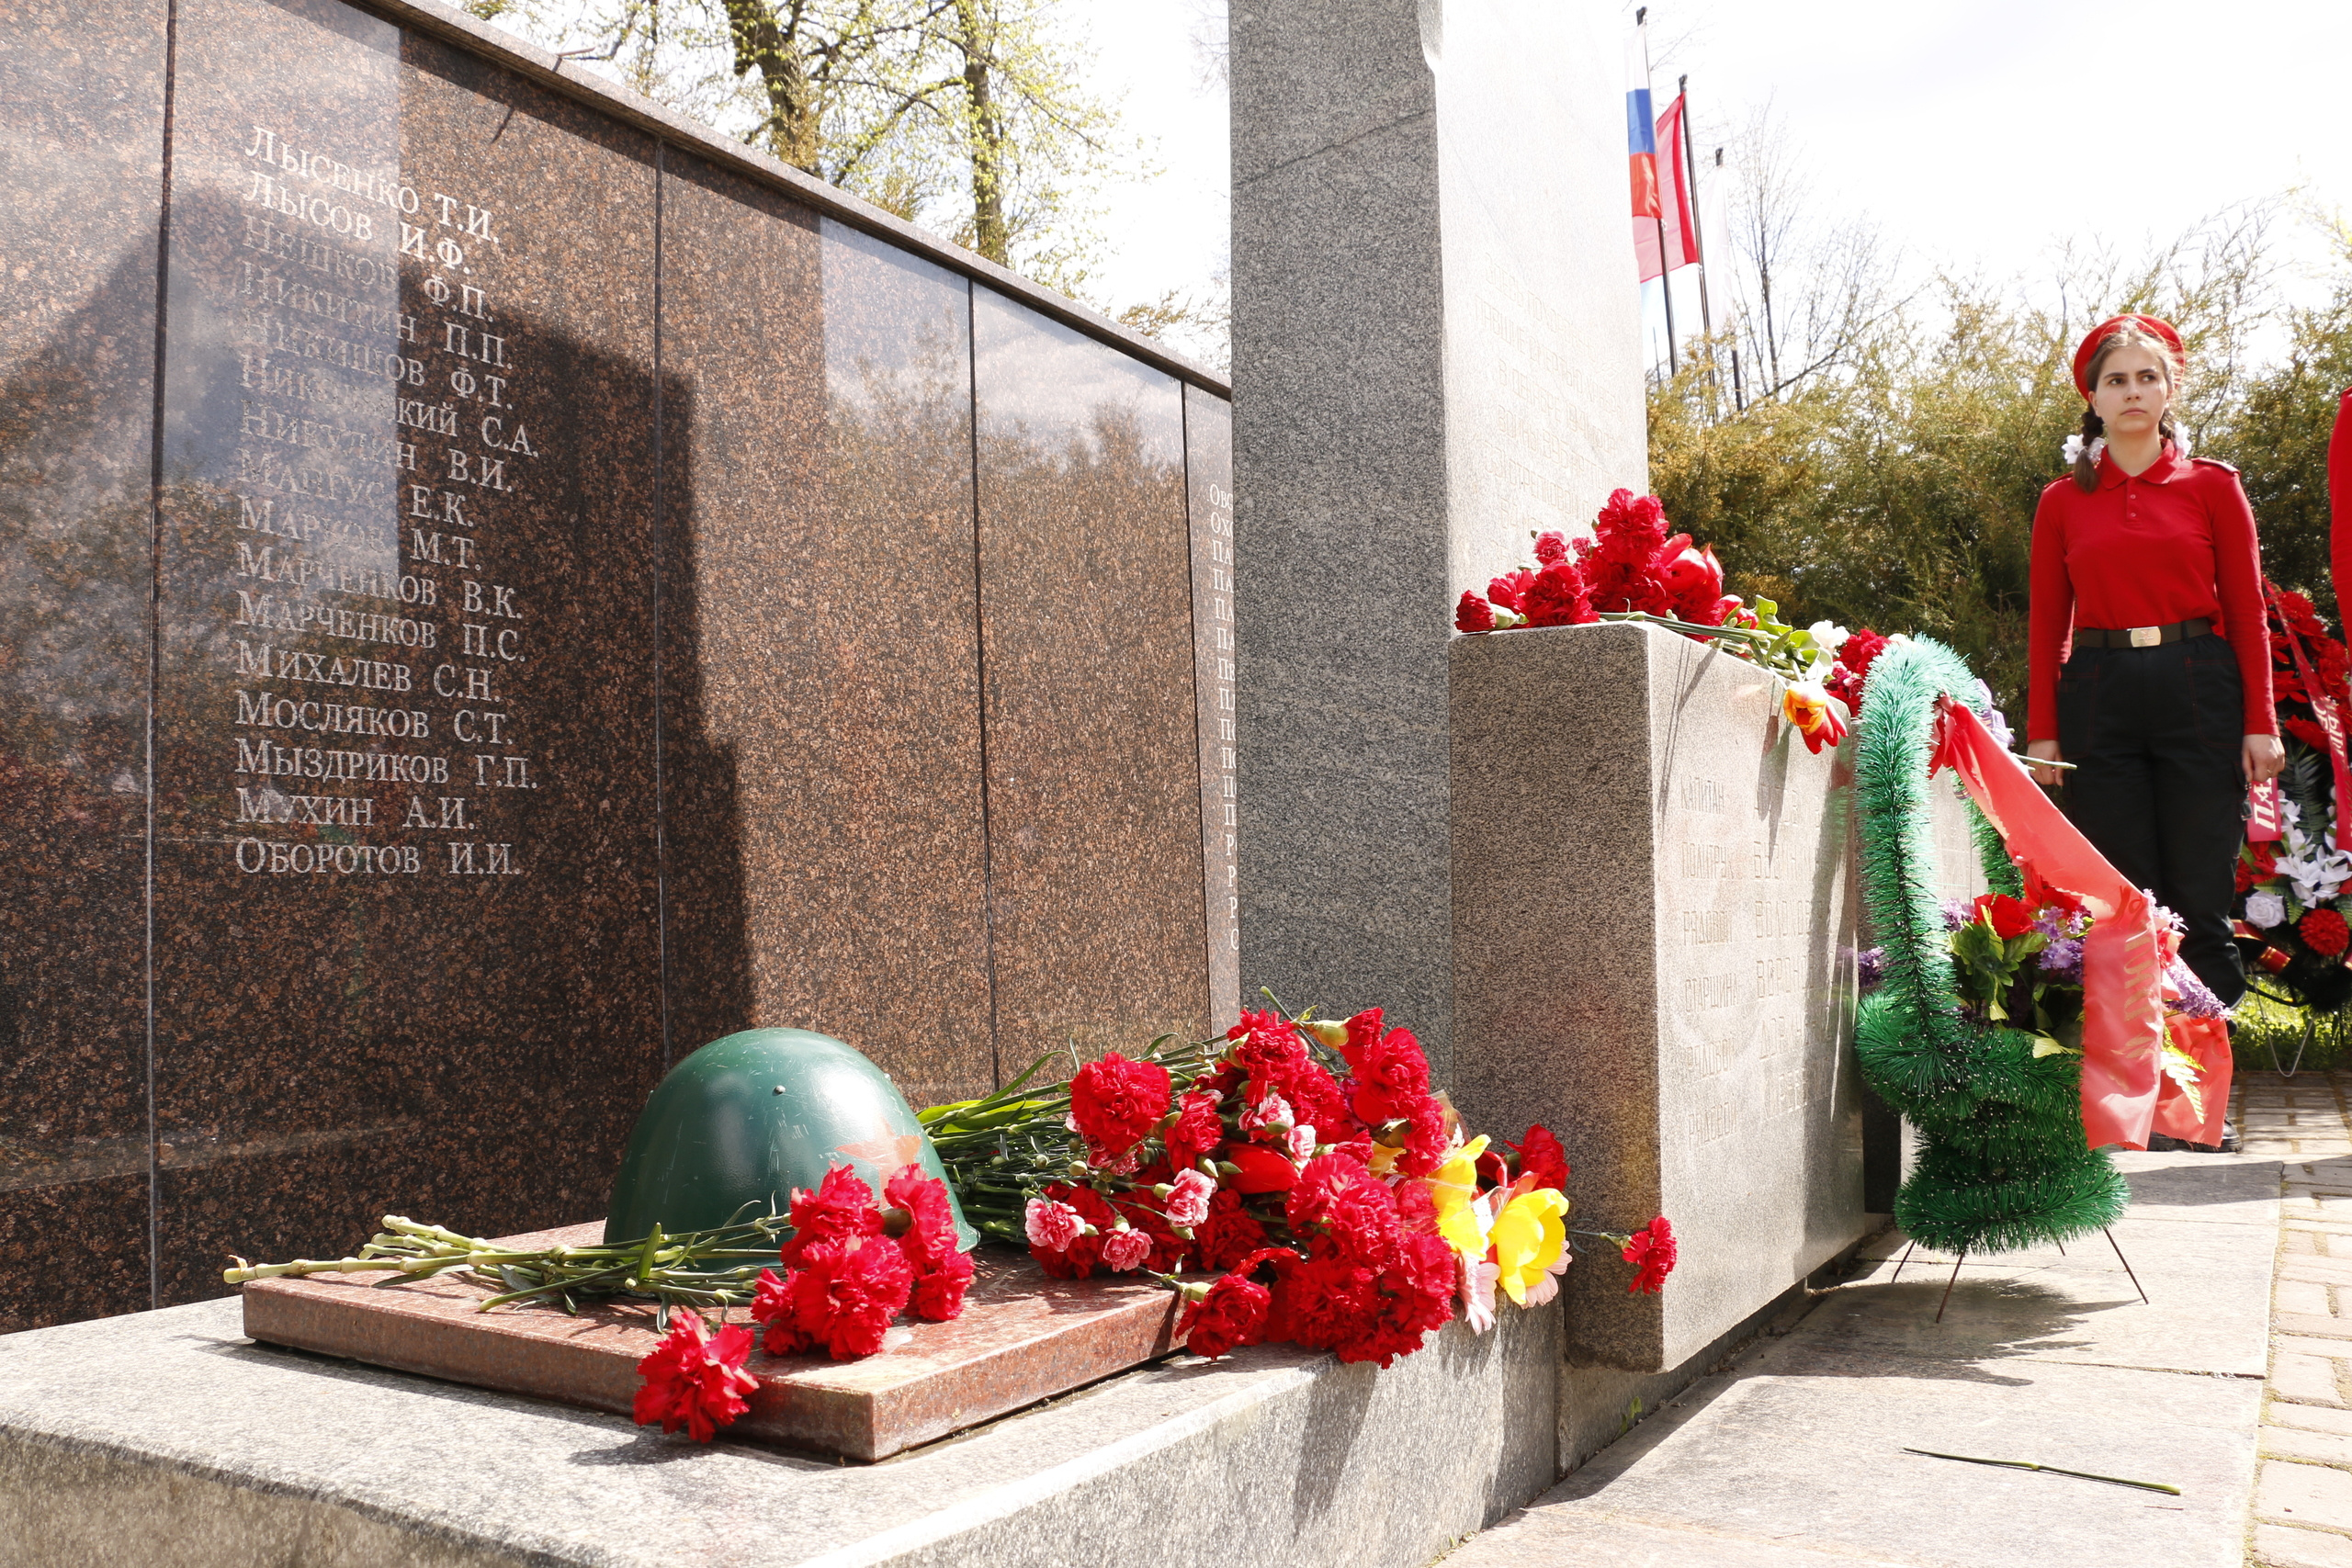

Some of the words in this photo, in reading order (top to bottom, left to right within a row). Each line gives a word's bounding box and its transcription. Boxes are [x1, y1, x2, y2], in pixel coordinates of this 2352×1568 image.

[244, 125, 419, 214] ЛЫСЕНКО
[434, 192, 500, 243] Т.И.
[243, 170, 373, 241] ЛЫСОВ
[399, 221, 470, 275] И.Ф.
[242, 214, 400, 288] НЕШКОВ
[424, 274, 494, 322] Ф.П.
[241, 261, 417, 344] НИКИТИН
[444, 321, 514, 370] П.П.
[450, 366, 513, 410] Ф.Т.
[481, 415, 539, 458] С.А.
[447, 447, 513, 493] В.И.
[236, 493, 388, 553] МАРКОВ
[409, 527, 481, 571] М.Т.
[410, 483, 474, 527] Е.К.
[236, 541, 437, 605] МАРЧЕНКОВ
[462, 580, 523, 620] В.К.
[234, 589, 436, 649] МАРЧЕНКОВ
[462, 623, 526, 662] П.С.
[235, 638, 413, 693] МИХАЛЕВ
[433, 664, 501, 704] С.Н.
[234, 689, 430, 739] МОСЛЯКОВ
[453, 708, 513, 746] С.Т.
[234, 737, 449, 784] МЫЗДРИКОВ
[474, 753, 538, 789] Г.П.
[235, 787, 374, 828] МУХИН
[401, 795, 475, 830] А.И.
[235, 836, 421, 874] ОБОРОТОВ
[447, 841, 521, 874] И.И.
